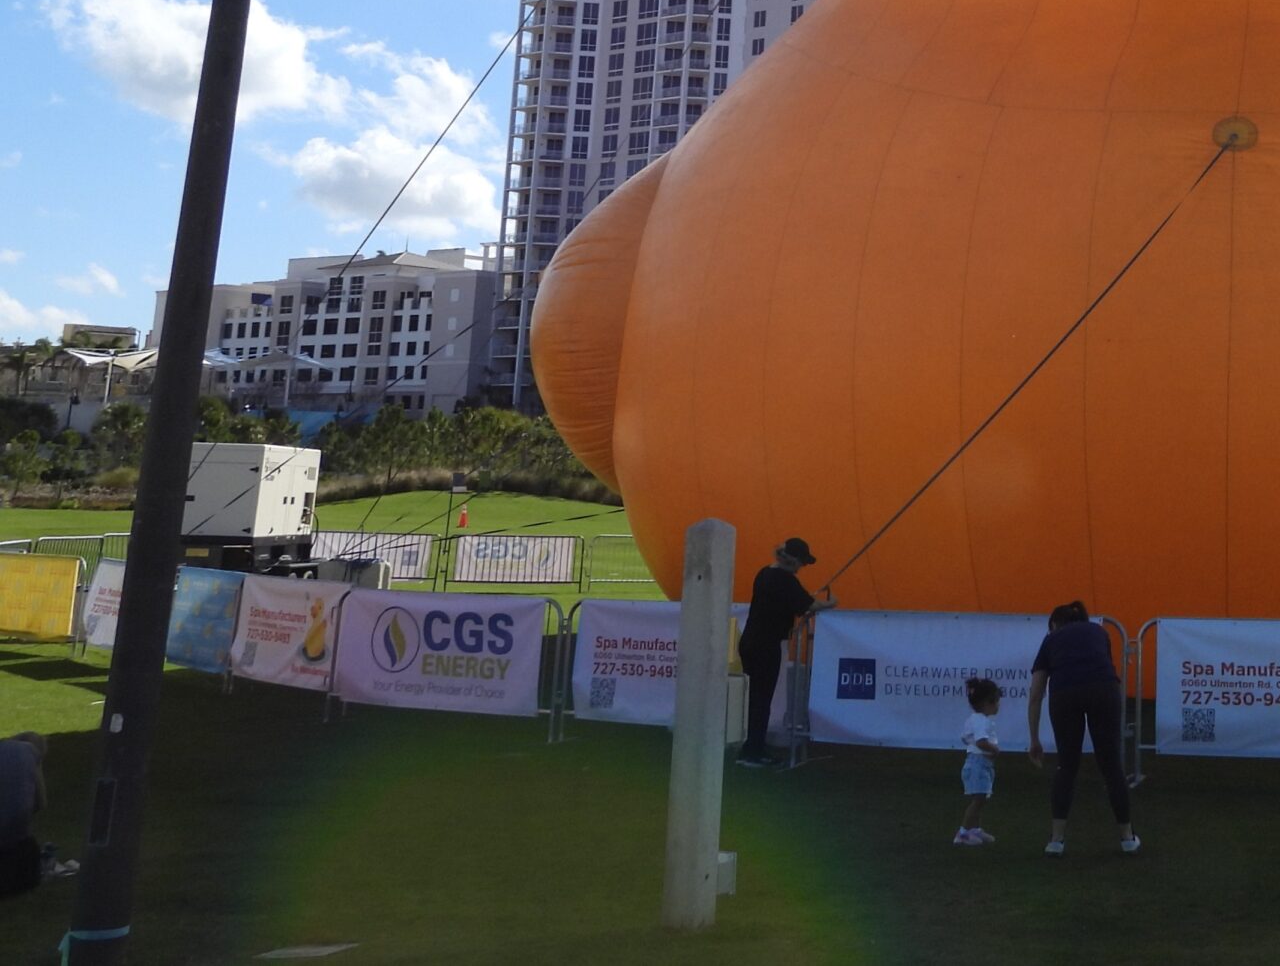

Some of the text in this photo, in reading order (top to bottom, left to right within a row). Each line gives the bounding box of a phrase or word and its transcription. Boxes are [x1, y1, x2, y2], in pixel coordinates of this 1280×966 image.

[423, 610, 514, 655] CGS
[595, 636, 618, 650] Spa
[421, 653, 512, 680] ENERGY
[884, 665, 1028, 680] CLEARWATER DOWN
[1181, 661, 1214, 677] Spa
[841, 672, 873, 685] DDB
[1181, 679, 1207, 687] 6060
[1210, 679, 1254, 688] Ulmerton
[1257, 680, 1273, 689] Rd.
[373, 680, 392, 692] Your
[395, 681, 425, 695] Energy
[474, 685, 506, 699] Choice
